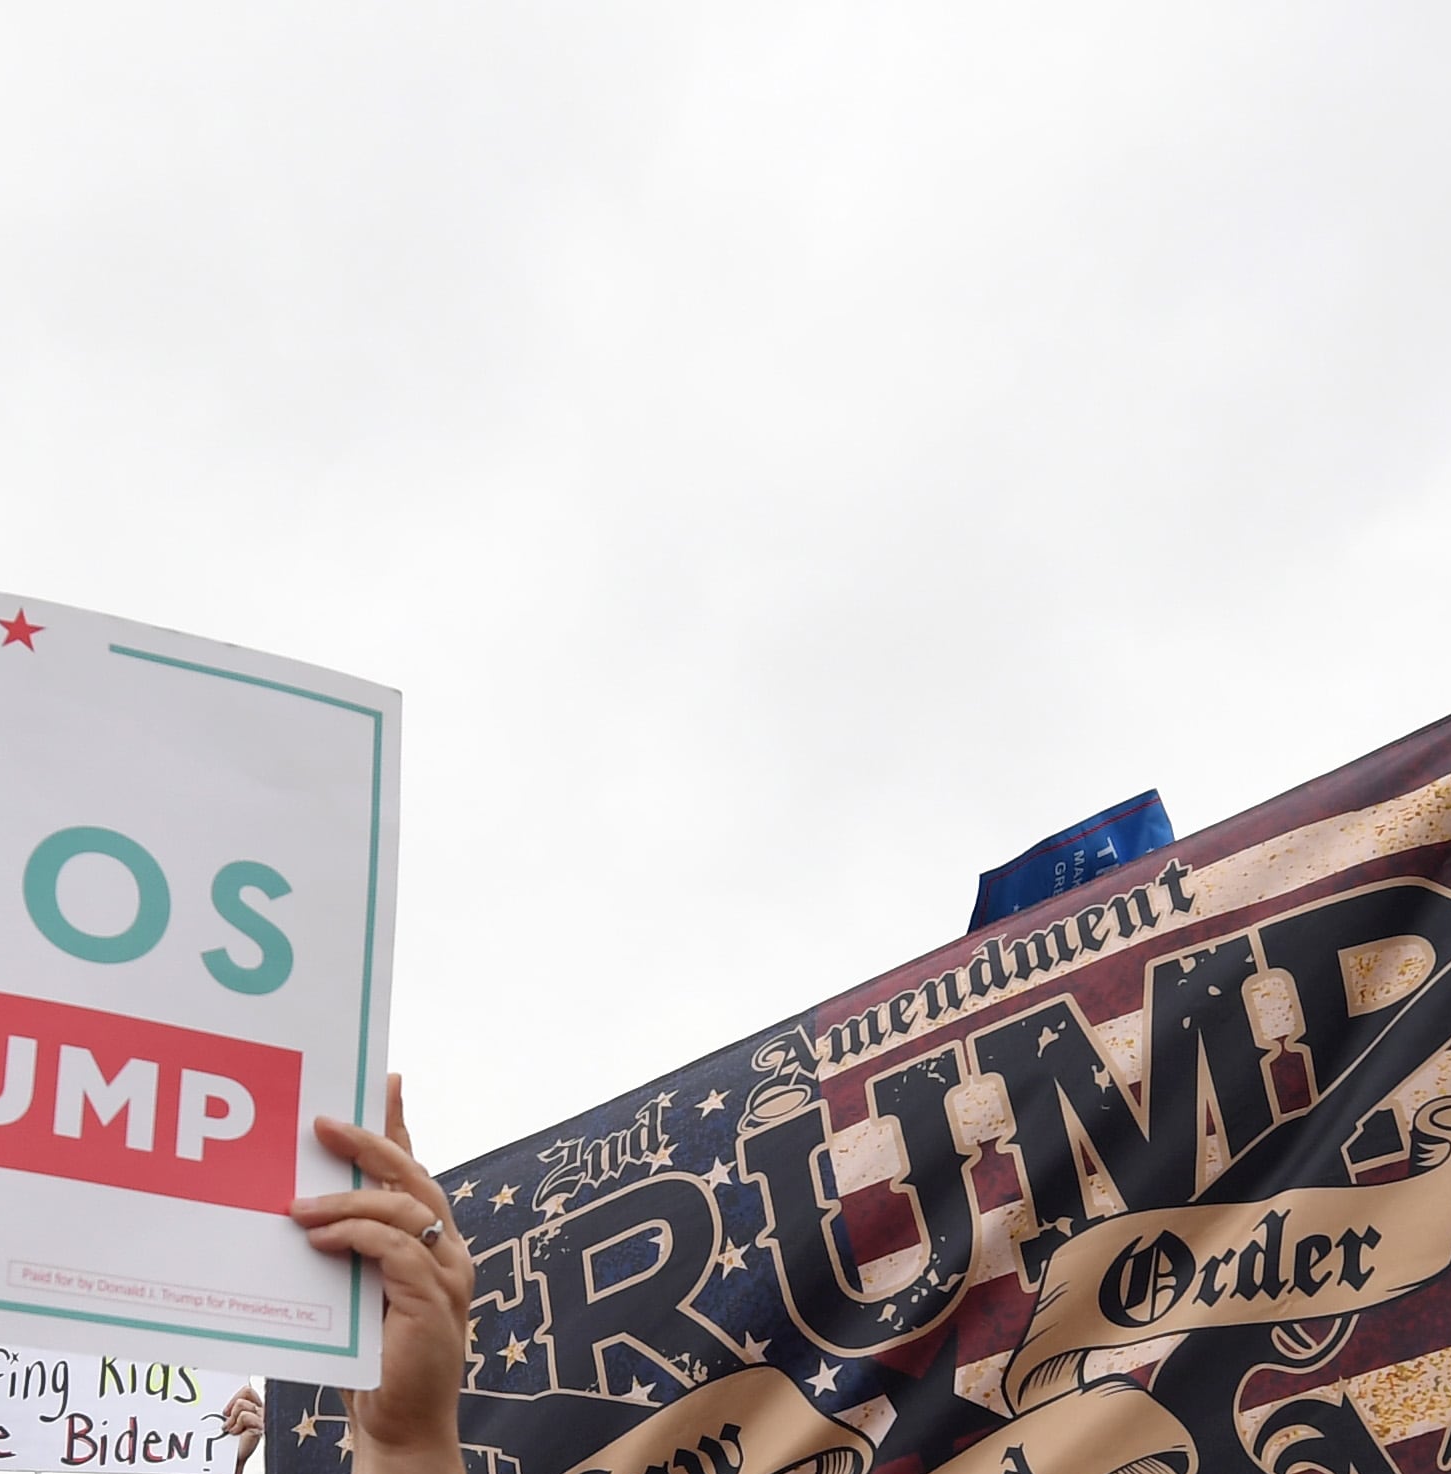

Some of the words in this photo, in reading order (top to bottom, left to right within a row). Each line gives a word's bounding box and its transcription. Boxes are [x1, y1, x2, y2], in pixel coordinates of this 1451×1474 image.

[534, 1088, 680, 1213] 2nd
[738, 857, 1199, 1140] Amendment
[21, 1267, 52, 1286] Paid
[54, 1271, 74, 1287] for
[77, 1275, 94, 1292] by
[97, 1278, 145, 1299] Donald
[162, 1288, 204, 1308] Trump
[207, 1293, 227, 1310] for
[1098, 1211, 1382, 1327] Order
